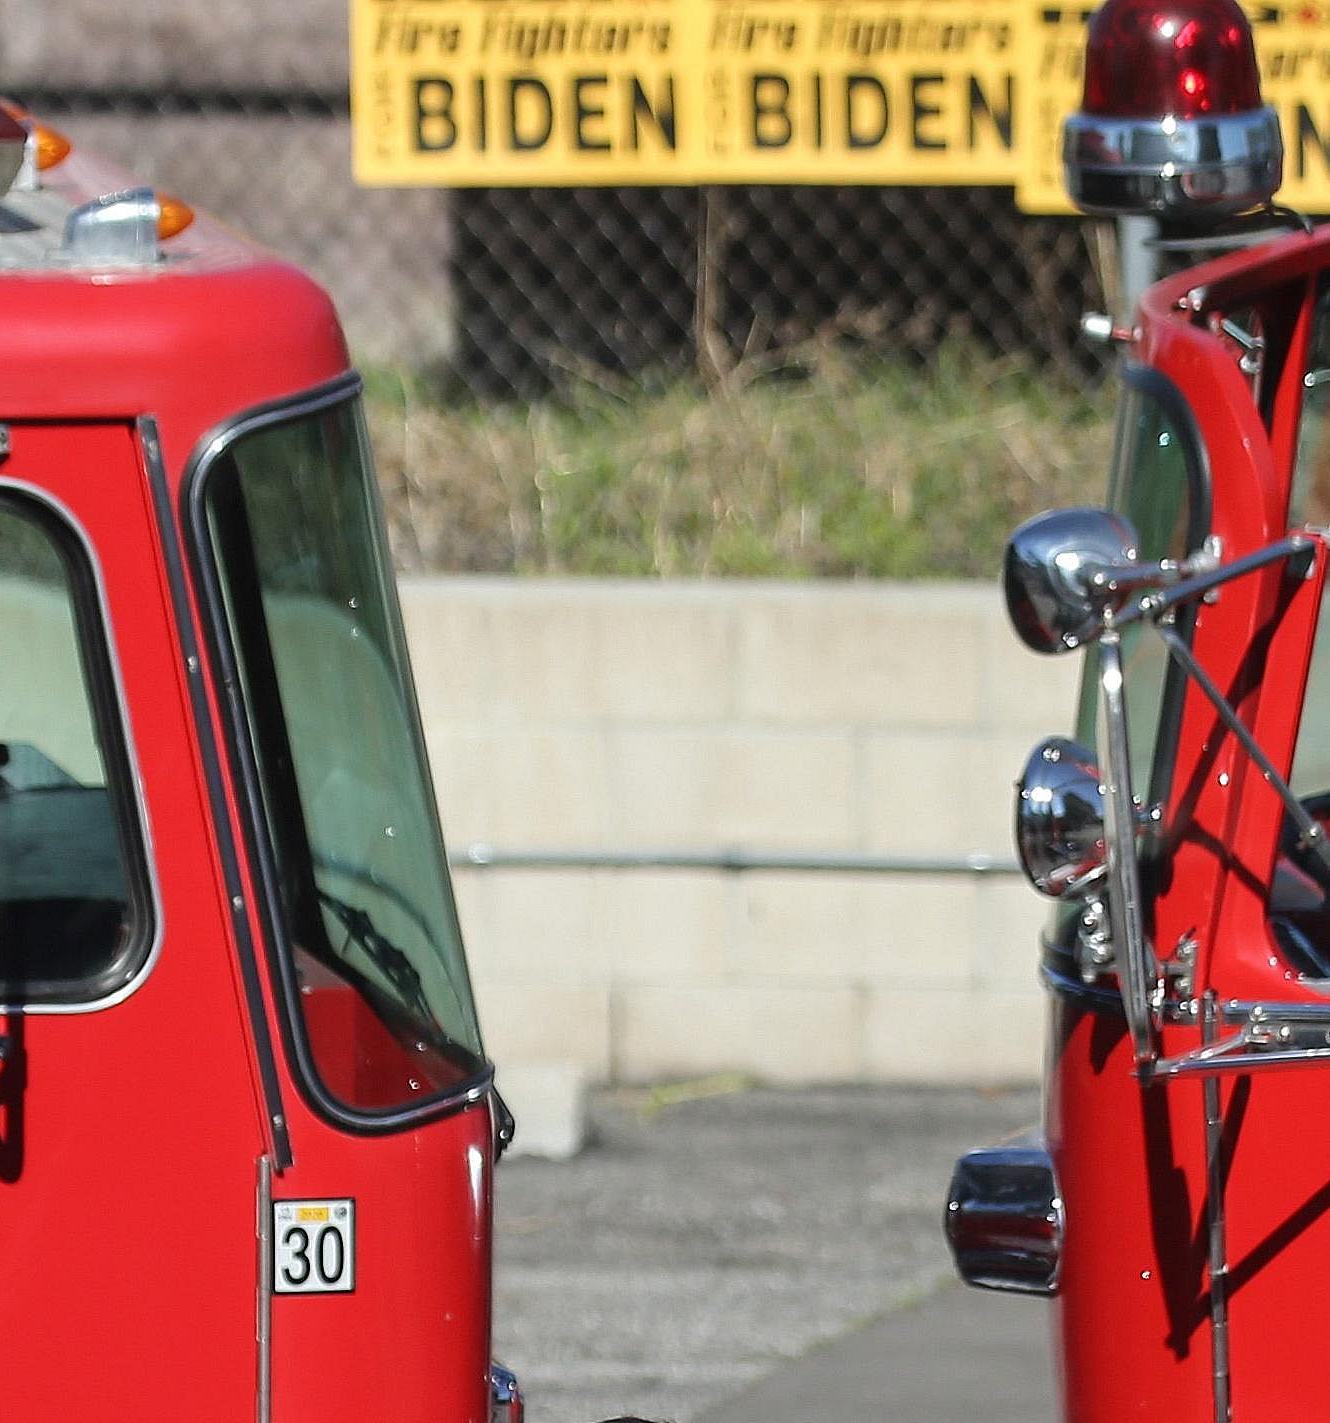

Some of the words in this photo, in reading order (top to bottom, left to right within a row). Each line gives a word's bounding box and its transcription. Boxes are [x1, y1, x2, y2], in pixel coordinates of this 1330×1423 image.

[411, 76, 677, 153] BIDEN
[752, 75, 1013, 152] BIDEN
[281, 1225, 345, 1285] 30
